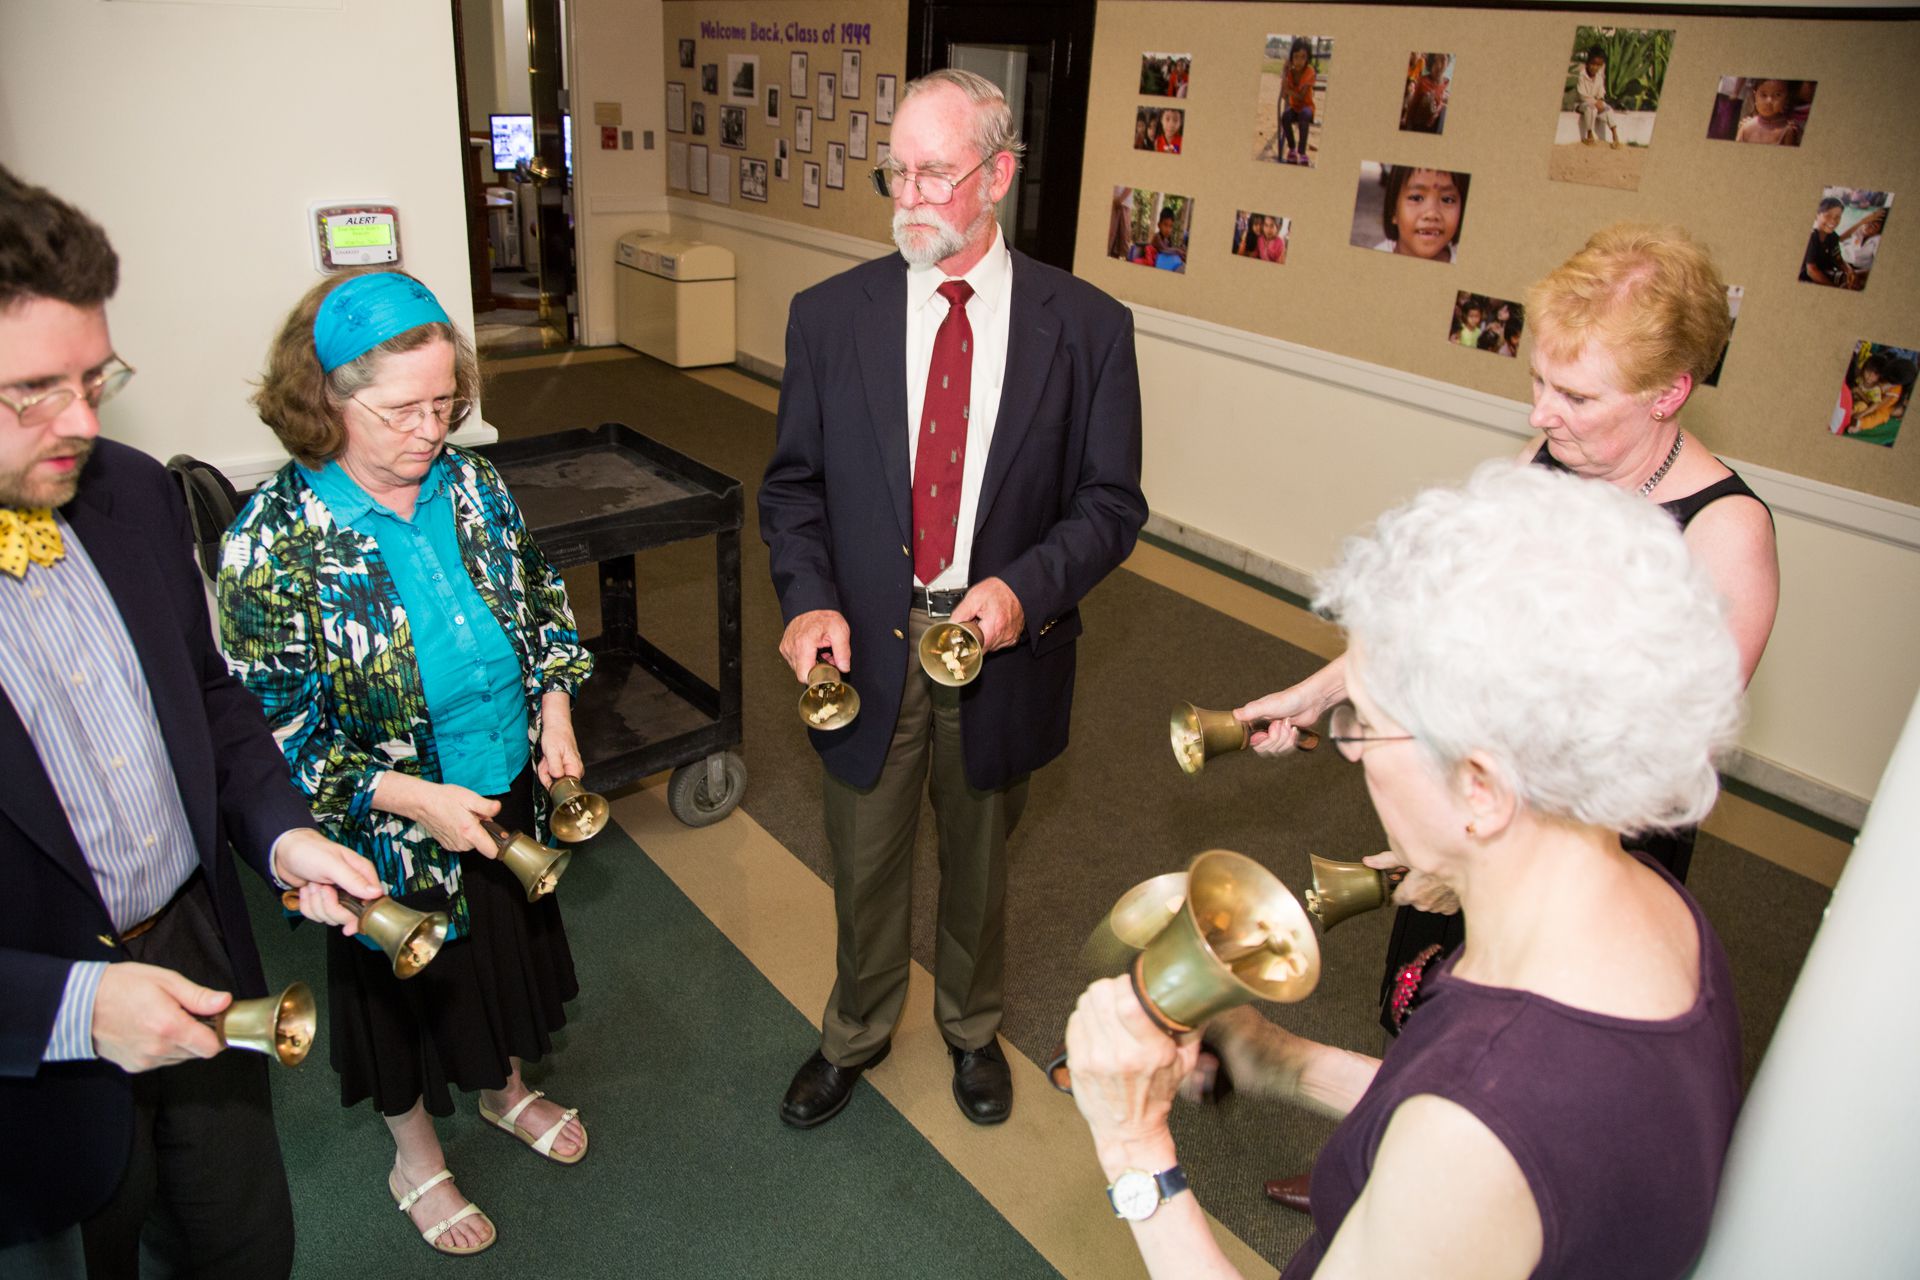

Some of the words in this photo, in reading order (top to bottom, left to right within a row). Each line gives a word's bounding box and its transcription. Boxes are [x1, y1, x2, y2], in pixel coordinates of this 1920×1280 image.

[701, 21, 746, 39] Welcome
[750, 22, 783, 44] Back,
[785, 22, 818, 43] Class
[822, 24, 836, 44] of
[841, 23, 871, 45] 1949
[346, 216, 377, 225] ALERT
